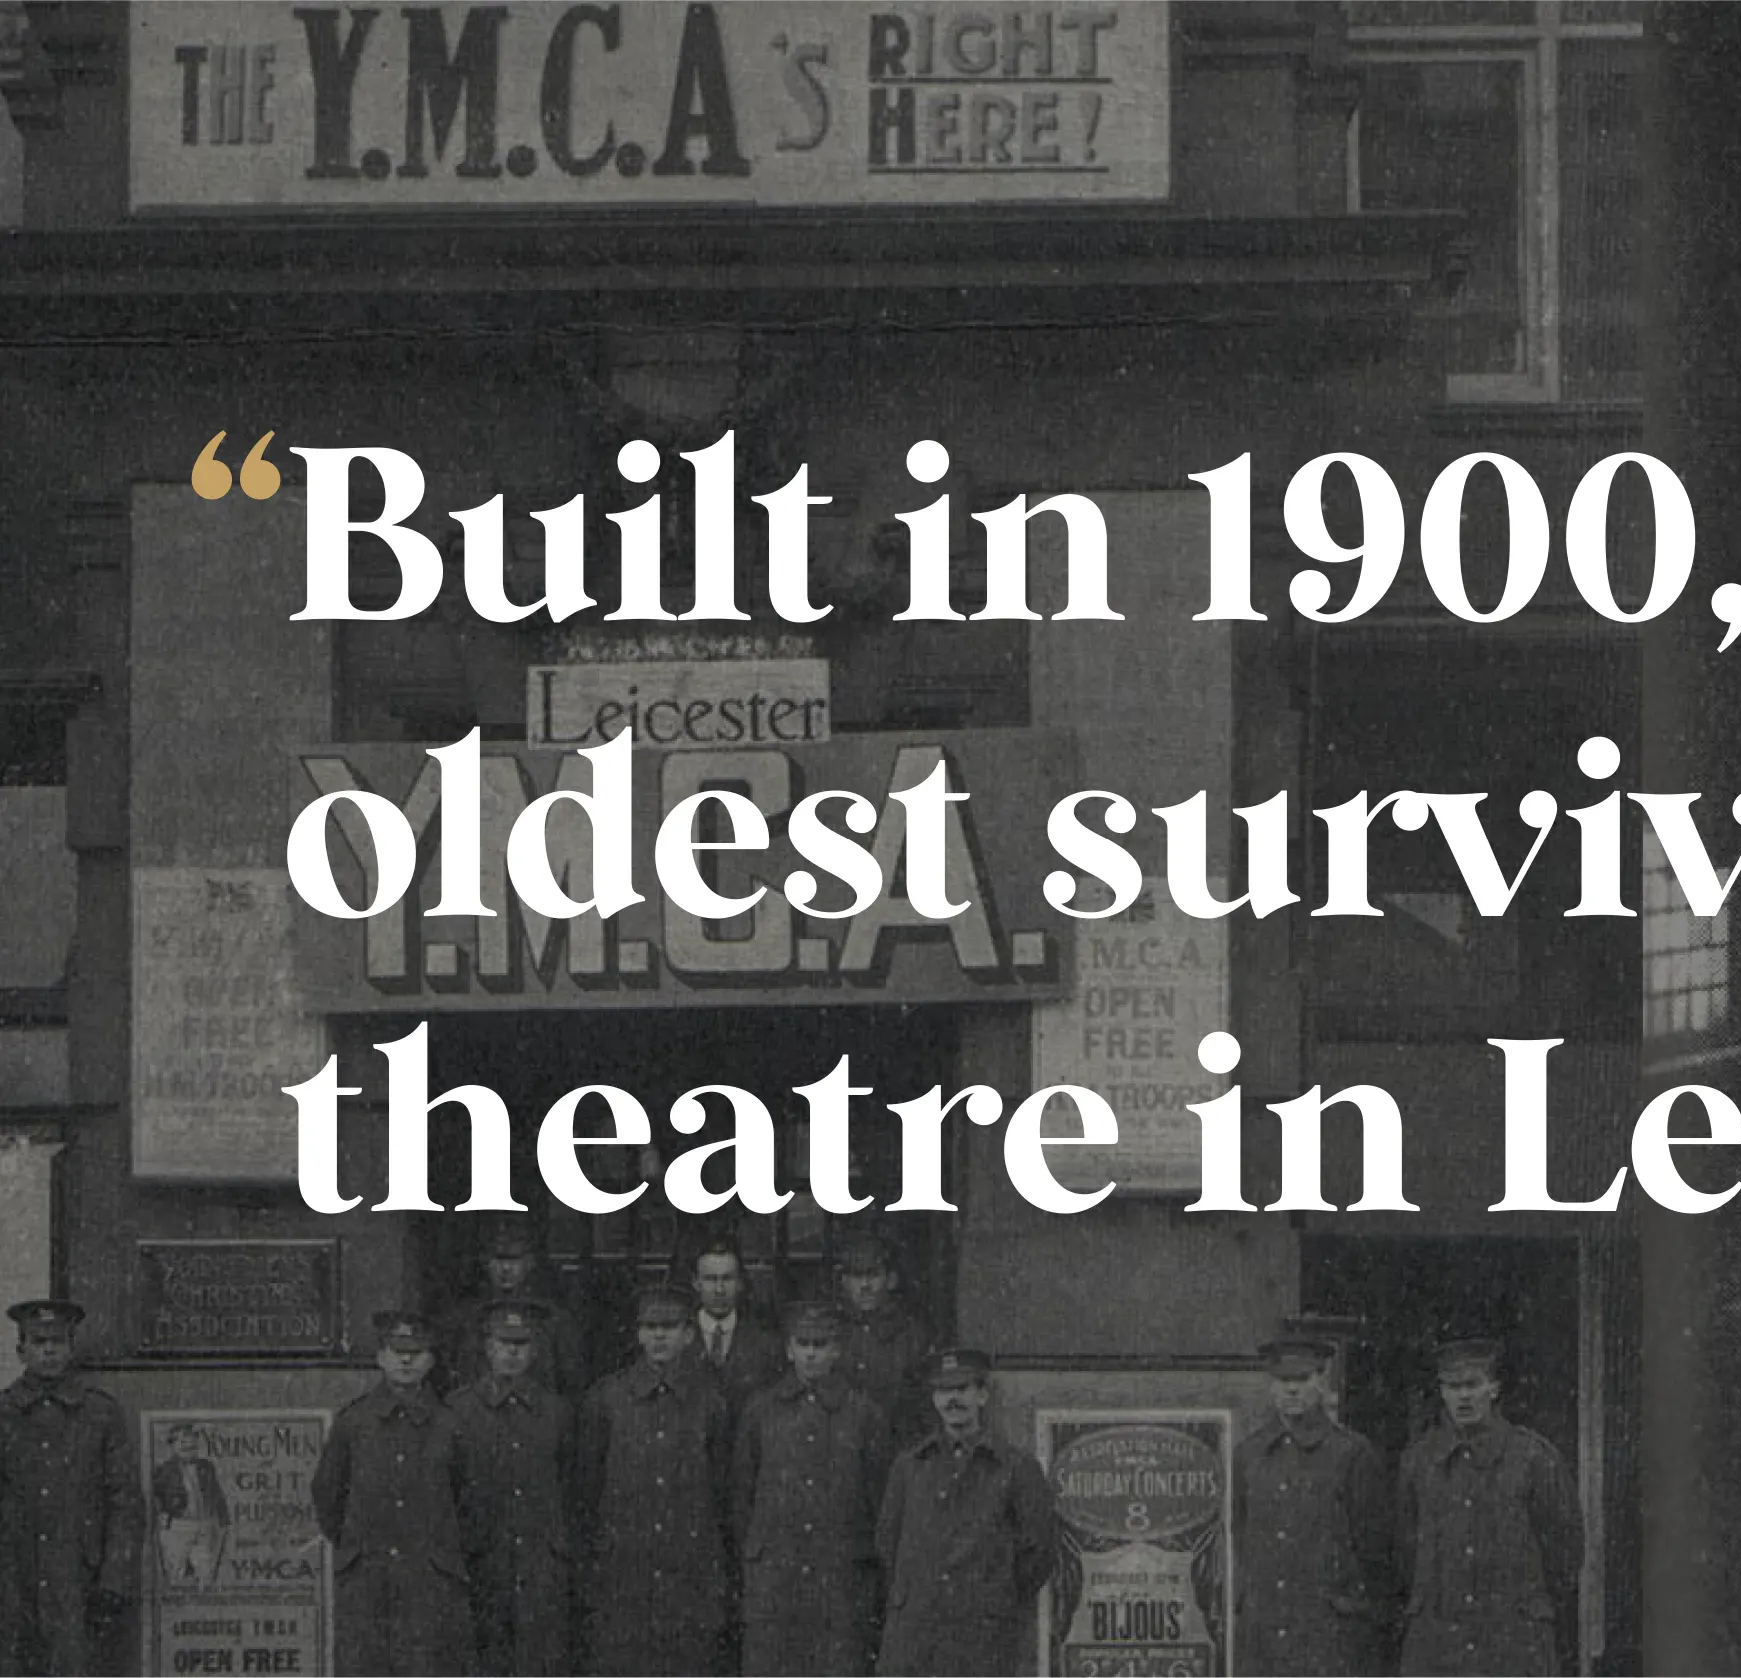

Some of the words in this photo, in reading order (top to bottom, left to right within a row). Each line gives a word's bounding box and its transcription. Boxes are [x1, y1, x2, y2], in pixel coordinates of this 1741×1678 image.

[868, 11, 1116, 79] RIGHT
[174, 44, 275, 146] THE
[868, 86, 1104, 167] HERE!
[537, 669, 827, 744] Leicester
[1083, 987, 1175, 1018] OPEN
[1083, 1028, 1175, 1061] FREE
[201, 1427, 271, 1458] YOUNG
[235, 1472, 305, 1491] GRIT
[1056, 1467, 1132, 1498] SATURDAY
[1134, 1465, 1218, 1498] CONCERTS
[1124, 1502, 1151, 1533] 8
[173, 1648, 232, 1672] OPEN
[243, 1648, 301, 1672] FREE
